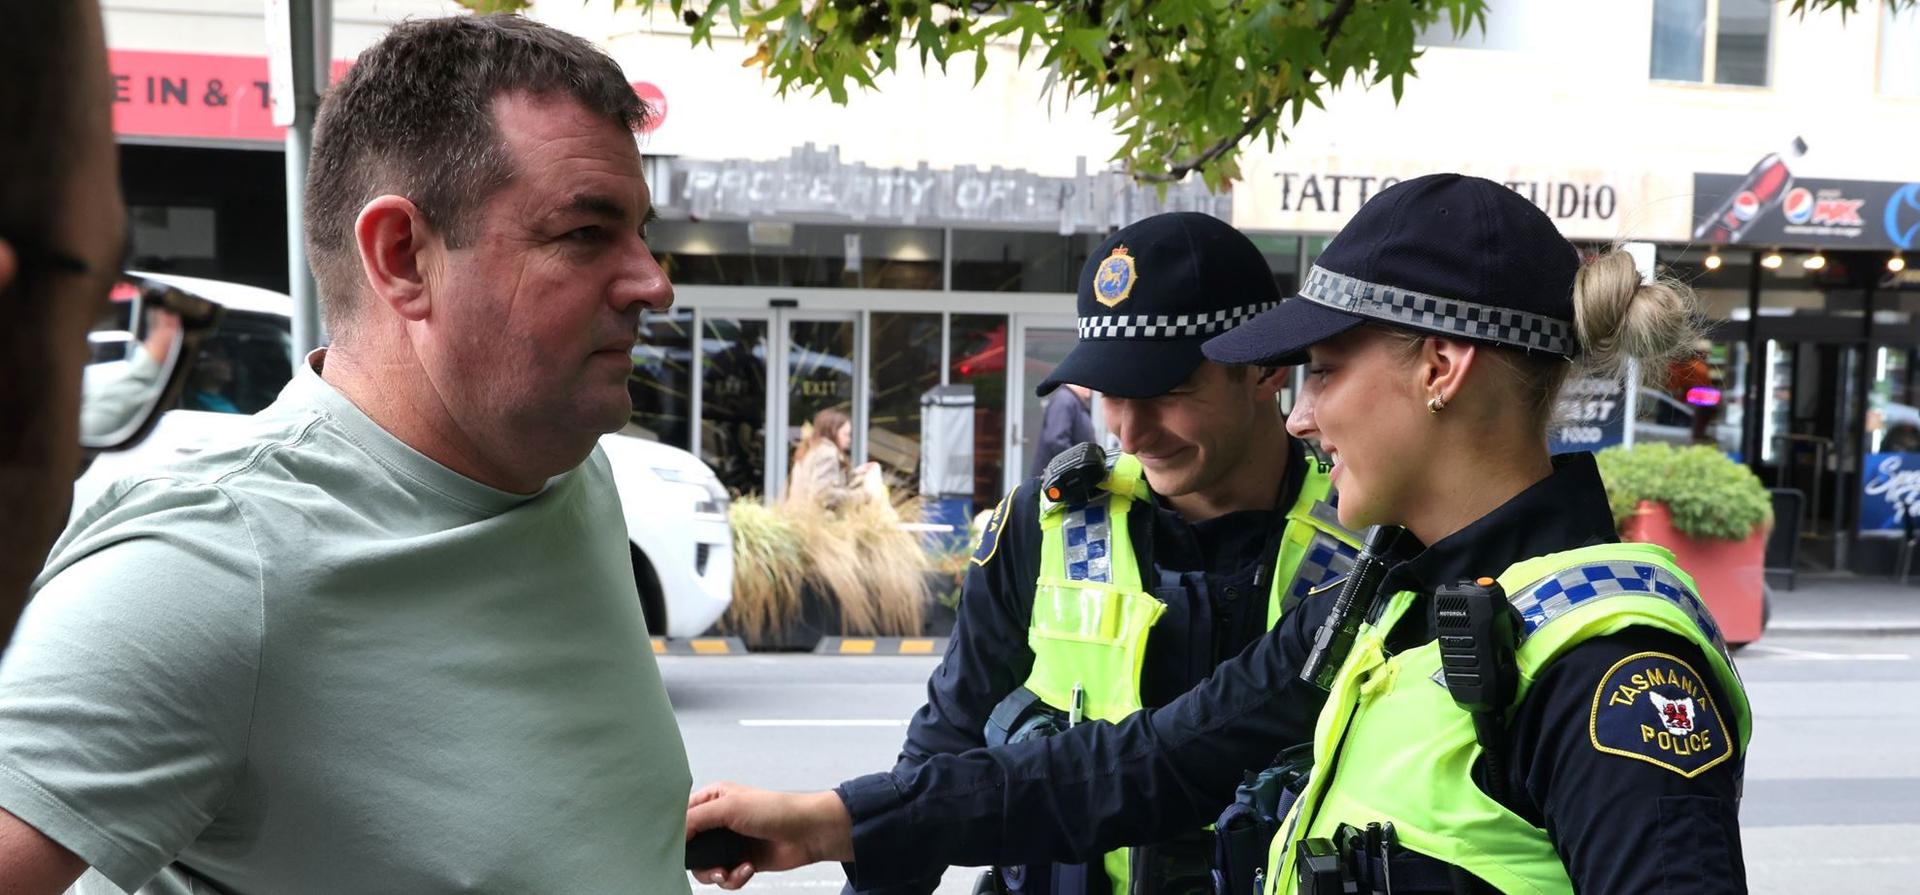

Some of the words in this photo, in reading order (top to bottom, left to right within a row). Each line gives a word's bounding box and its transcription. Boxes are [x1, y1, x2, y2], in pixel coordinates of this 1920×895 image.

[147, 76, 189, 105] IN
[203, 78, 228, 107] &
[1608, 667, 1707, 713] TASMANIA
[1640, 723, 1713, 756] POLICE
